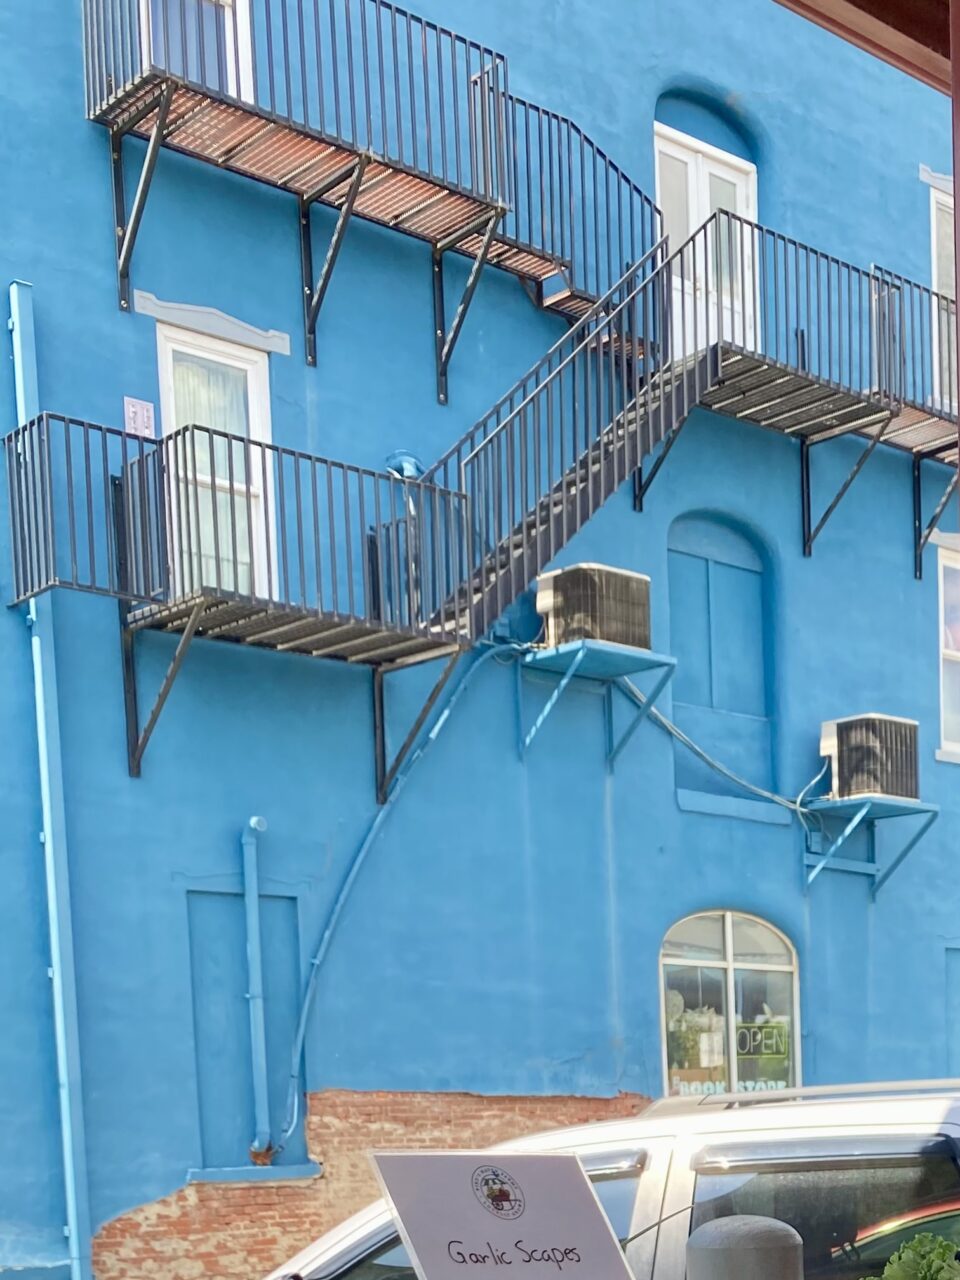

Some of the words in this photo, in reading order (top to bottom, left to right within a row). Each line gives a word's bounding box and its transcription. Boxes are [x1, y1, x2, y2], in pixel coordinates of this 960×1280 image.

[737, 1028, 786, 1053] OPEN
[448, 1240, 512, 1265] Garlic
[515, 1240, 580, 1270] Scapes
